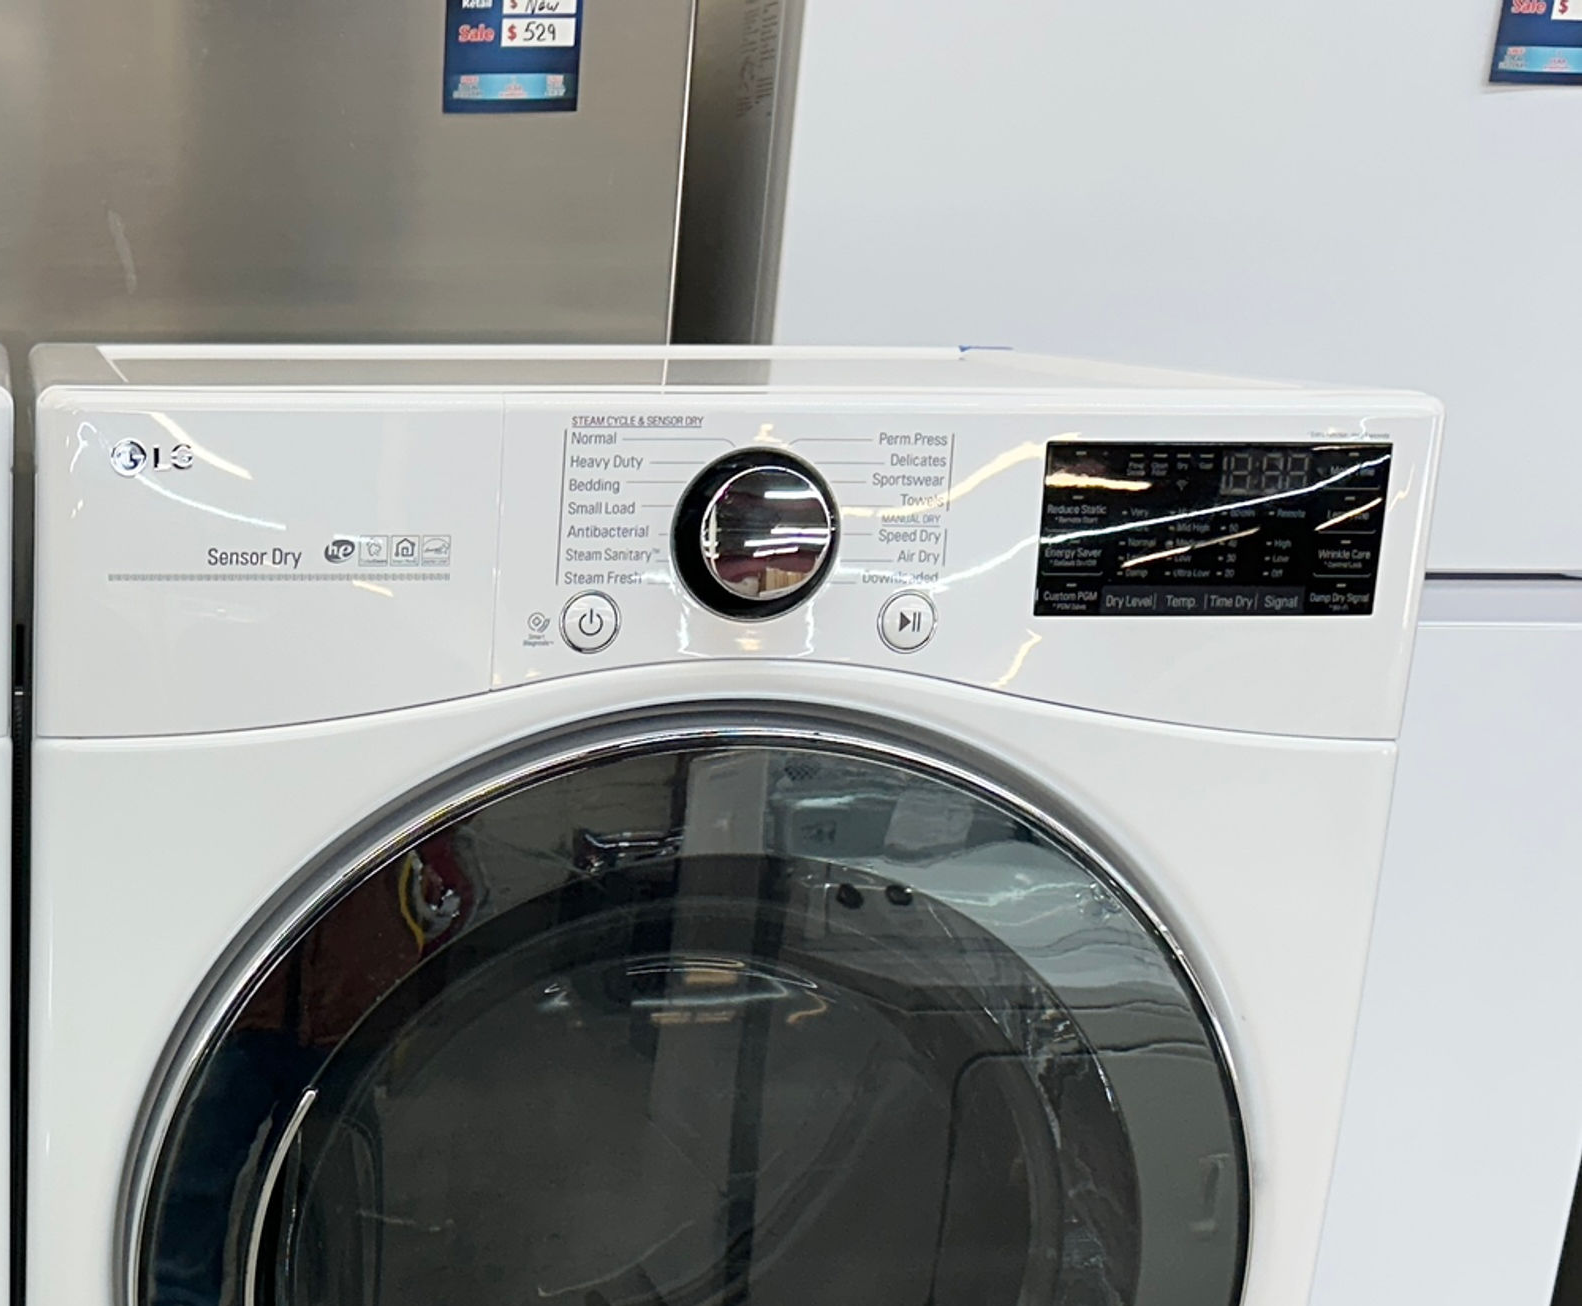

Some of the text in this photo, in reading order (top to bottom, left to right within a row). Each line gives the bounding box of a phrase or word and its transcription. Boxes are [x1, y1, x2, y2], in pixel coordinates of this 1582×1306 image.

[1511, 0, 1546, 14] Sale
[458, 23, 495, 42] Sale
[571, 415, 704, 428] STEAM CYCLE & SENSOR DRY
[571, 431, 617, 445] Normal
[153, 443, 194, 472] LG
[570, 455, 643, 470] Heavy Duty
[890, 453, 947, 467] Delicates
[569, 478, 620, 494] Bedding
[872, 472, 945, 488] Sportswear
[568, 501, 635, 515] Small Load
[1047, 503, 1107, 515] Reduce Static
[882, 514, 941, 523] MANUAL DRY
[567, 525, 649, 538] Antibacterial
[878, 529, 941, 545] Speed Dry
[207, 547, 302, 569] Sensor Dry
[565, 548, 602, 561] Steam
[897, 549, 940, 566] Air Dry
[1044, 547, 1103, 559] Energy Saver
[1318, 549, 1372, 560] Wrinkle Care
[564, 571, 604, 585] Steam
[1043, 590, 1099, 602] Custom PGM
[1105, 593, 1153, 610] Dry Level
[1209, 594, 1254, 611] Time Dry
[1264, 594, 1299, 611] Signal
[1309, 592, 1371, 605] Damp Dry Signal
